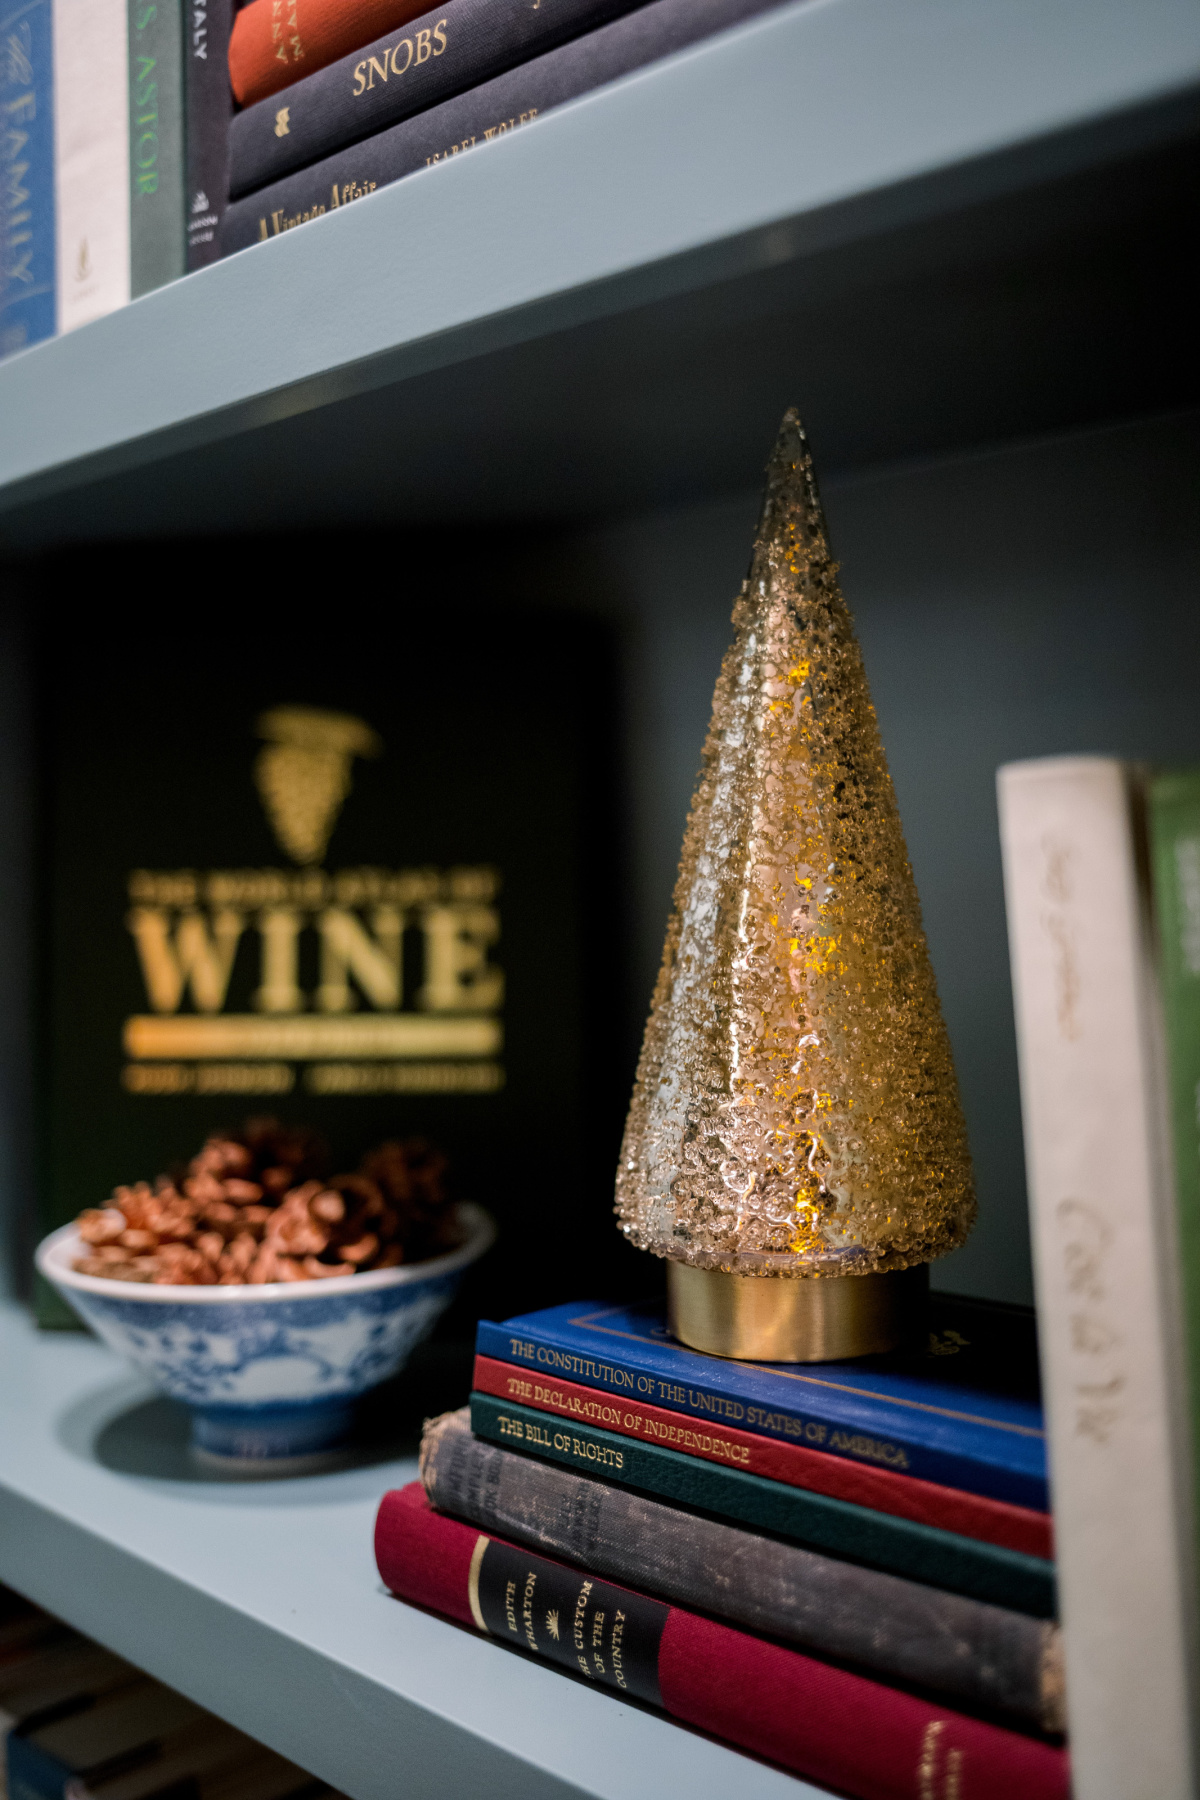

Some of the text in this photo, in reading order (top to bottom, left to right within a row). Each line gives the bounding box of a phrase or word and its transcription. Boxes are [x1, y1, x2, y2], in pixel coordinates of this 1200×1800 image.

[352, 18, 448, 97] SNOBS
[134, 55, 159, 195] ASTOR
[330, 180, 377, 211] Affair
[127, 905, 507, 1012] WINE
[497, 1415, 624, 1470] THE BILL OF RIGHTS
[507, 1377, 751, 1466] THE DECLARATION OF INDEPENDENCE
[509, 1339, 909, 1468] THE CONSTITUTION OF THE UNITED STATES OF AMERICA
[505, 1580, 517, 1633] EDITH
[522, 1571, 538, 1652] WHARTON
[574, 1580, 594, 1650] CUSTOM
[592, 1611, 606, 1675] OF THE
[611, 1608, 628, 1690] COUNTRY
